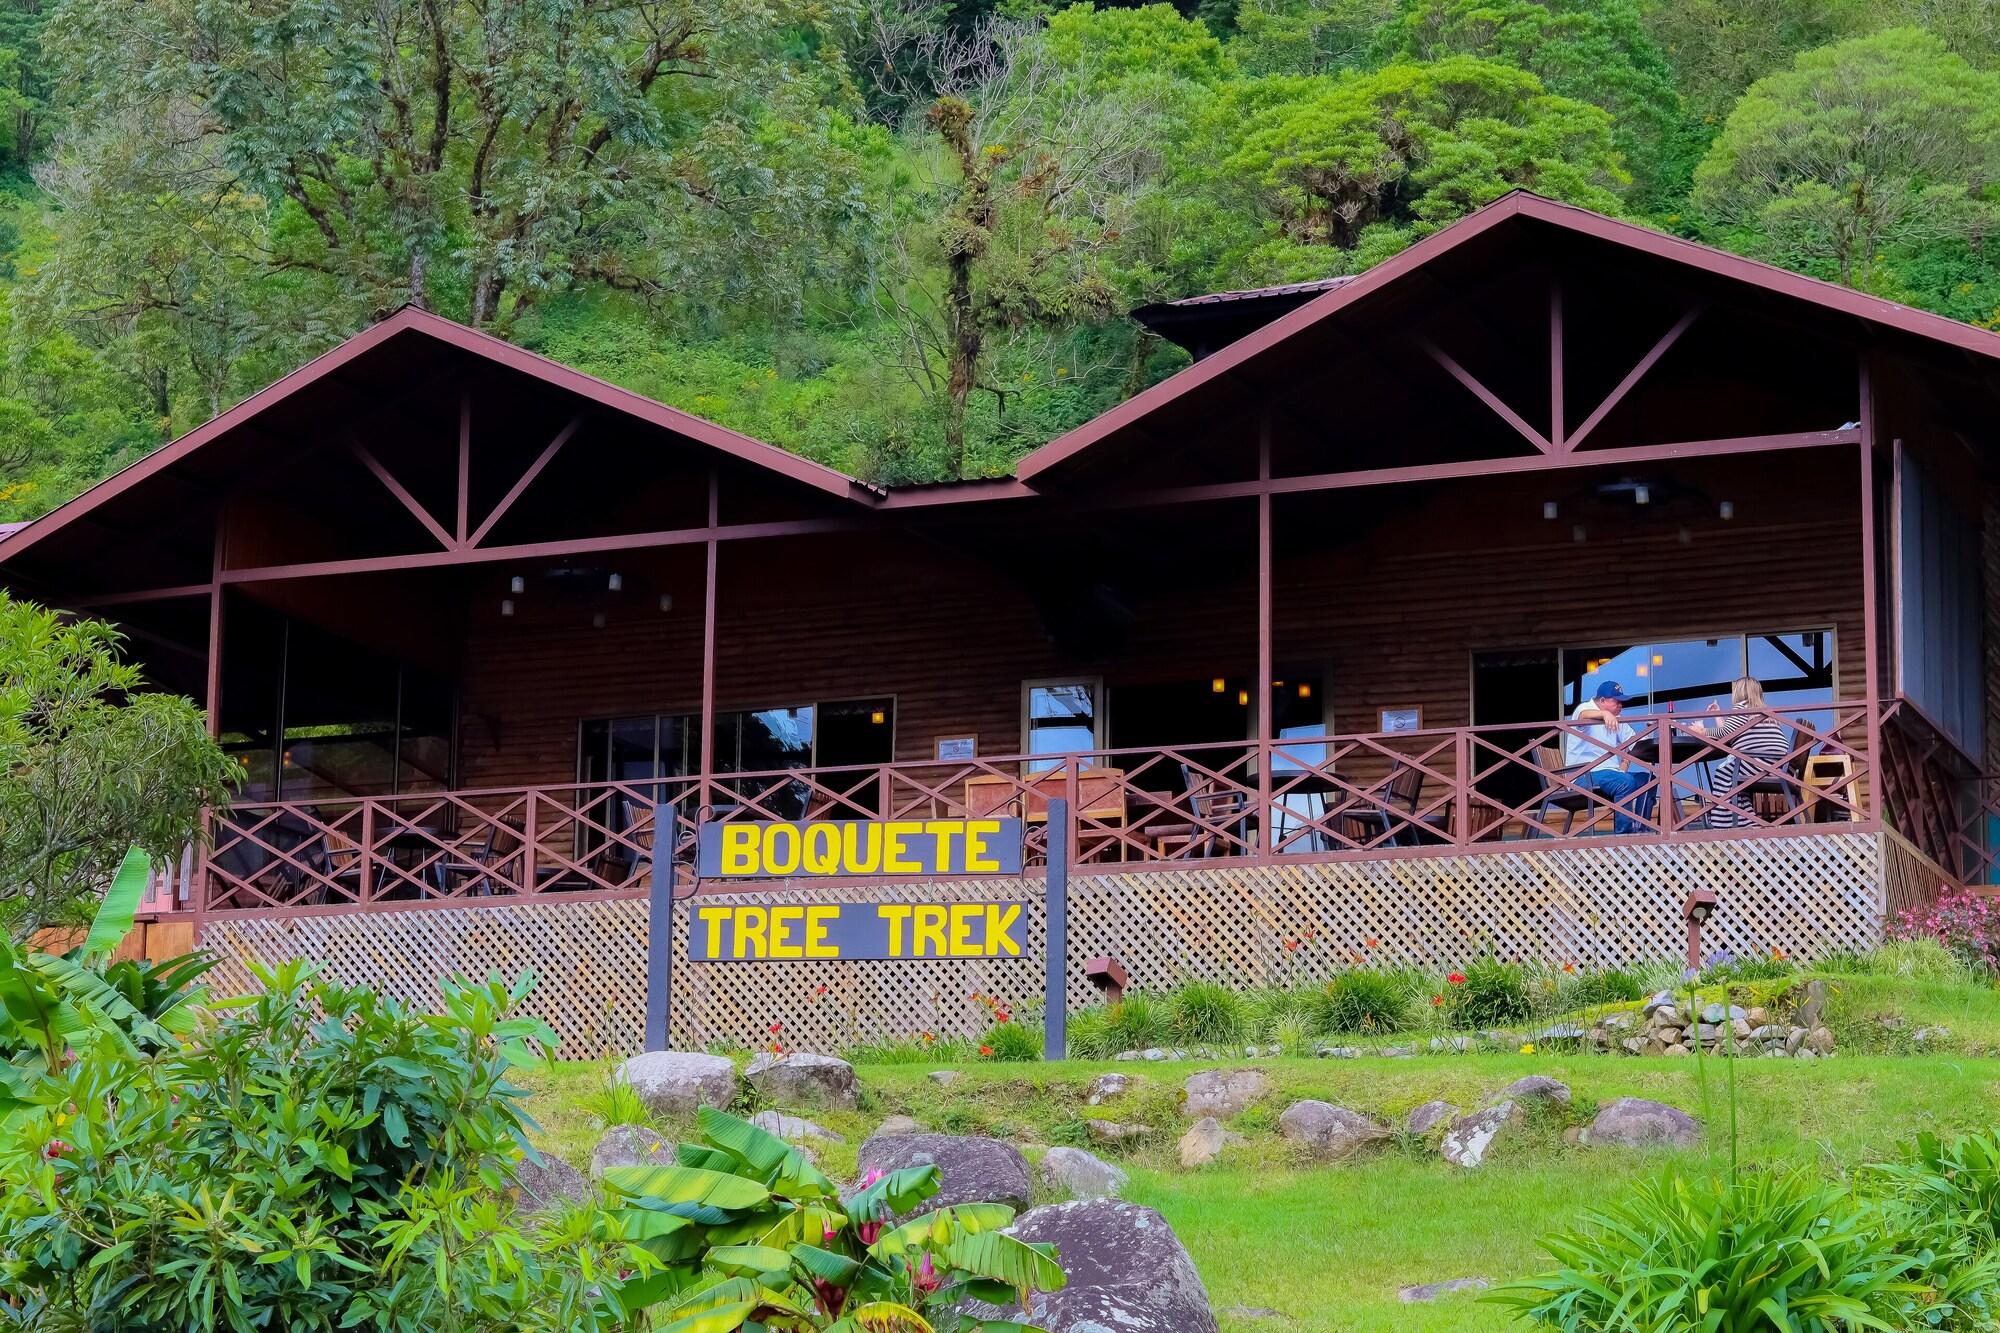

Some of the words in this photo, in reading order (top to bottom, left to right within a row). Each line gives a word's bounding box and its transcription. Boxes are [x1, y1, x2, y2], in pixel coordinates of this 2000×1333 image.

[721, 820, 1000, 875] BOQUETE
[699, 905, 840, 959] TREE
[878, 904, 1021, 957] TREK
